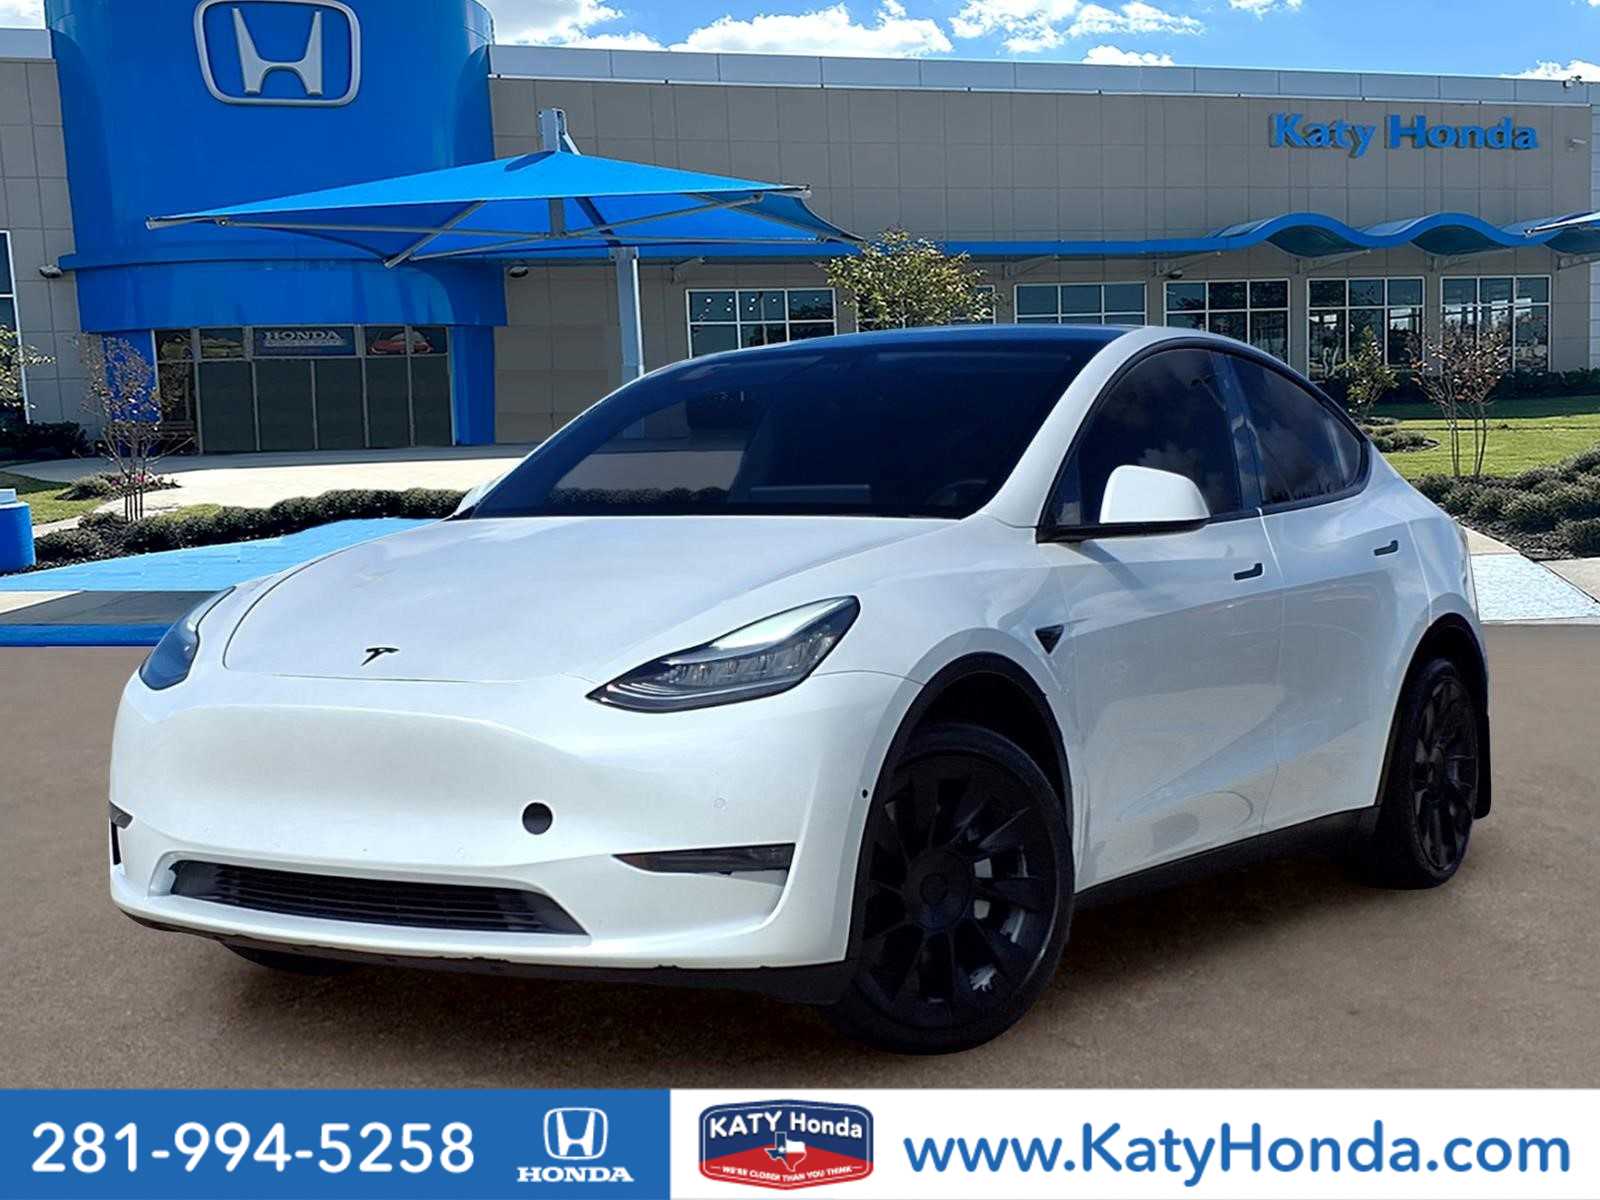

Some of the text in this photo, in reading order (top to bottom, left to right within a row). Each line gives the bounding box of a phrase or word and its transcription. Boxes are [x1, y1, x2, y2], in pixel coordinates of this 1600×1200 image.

[1270, 112, 1538, 157] Katy Honda
[264, 330, 343, 341] HONDA
